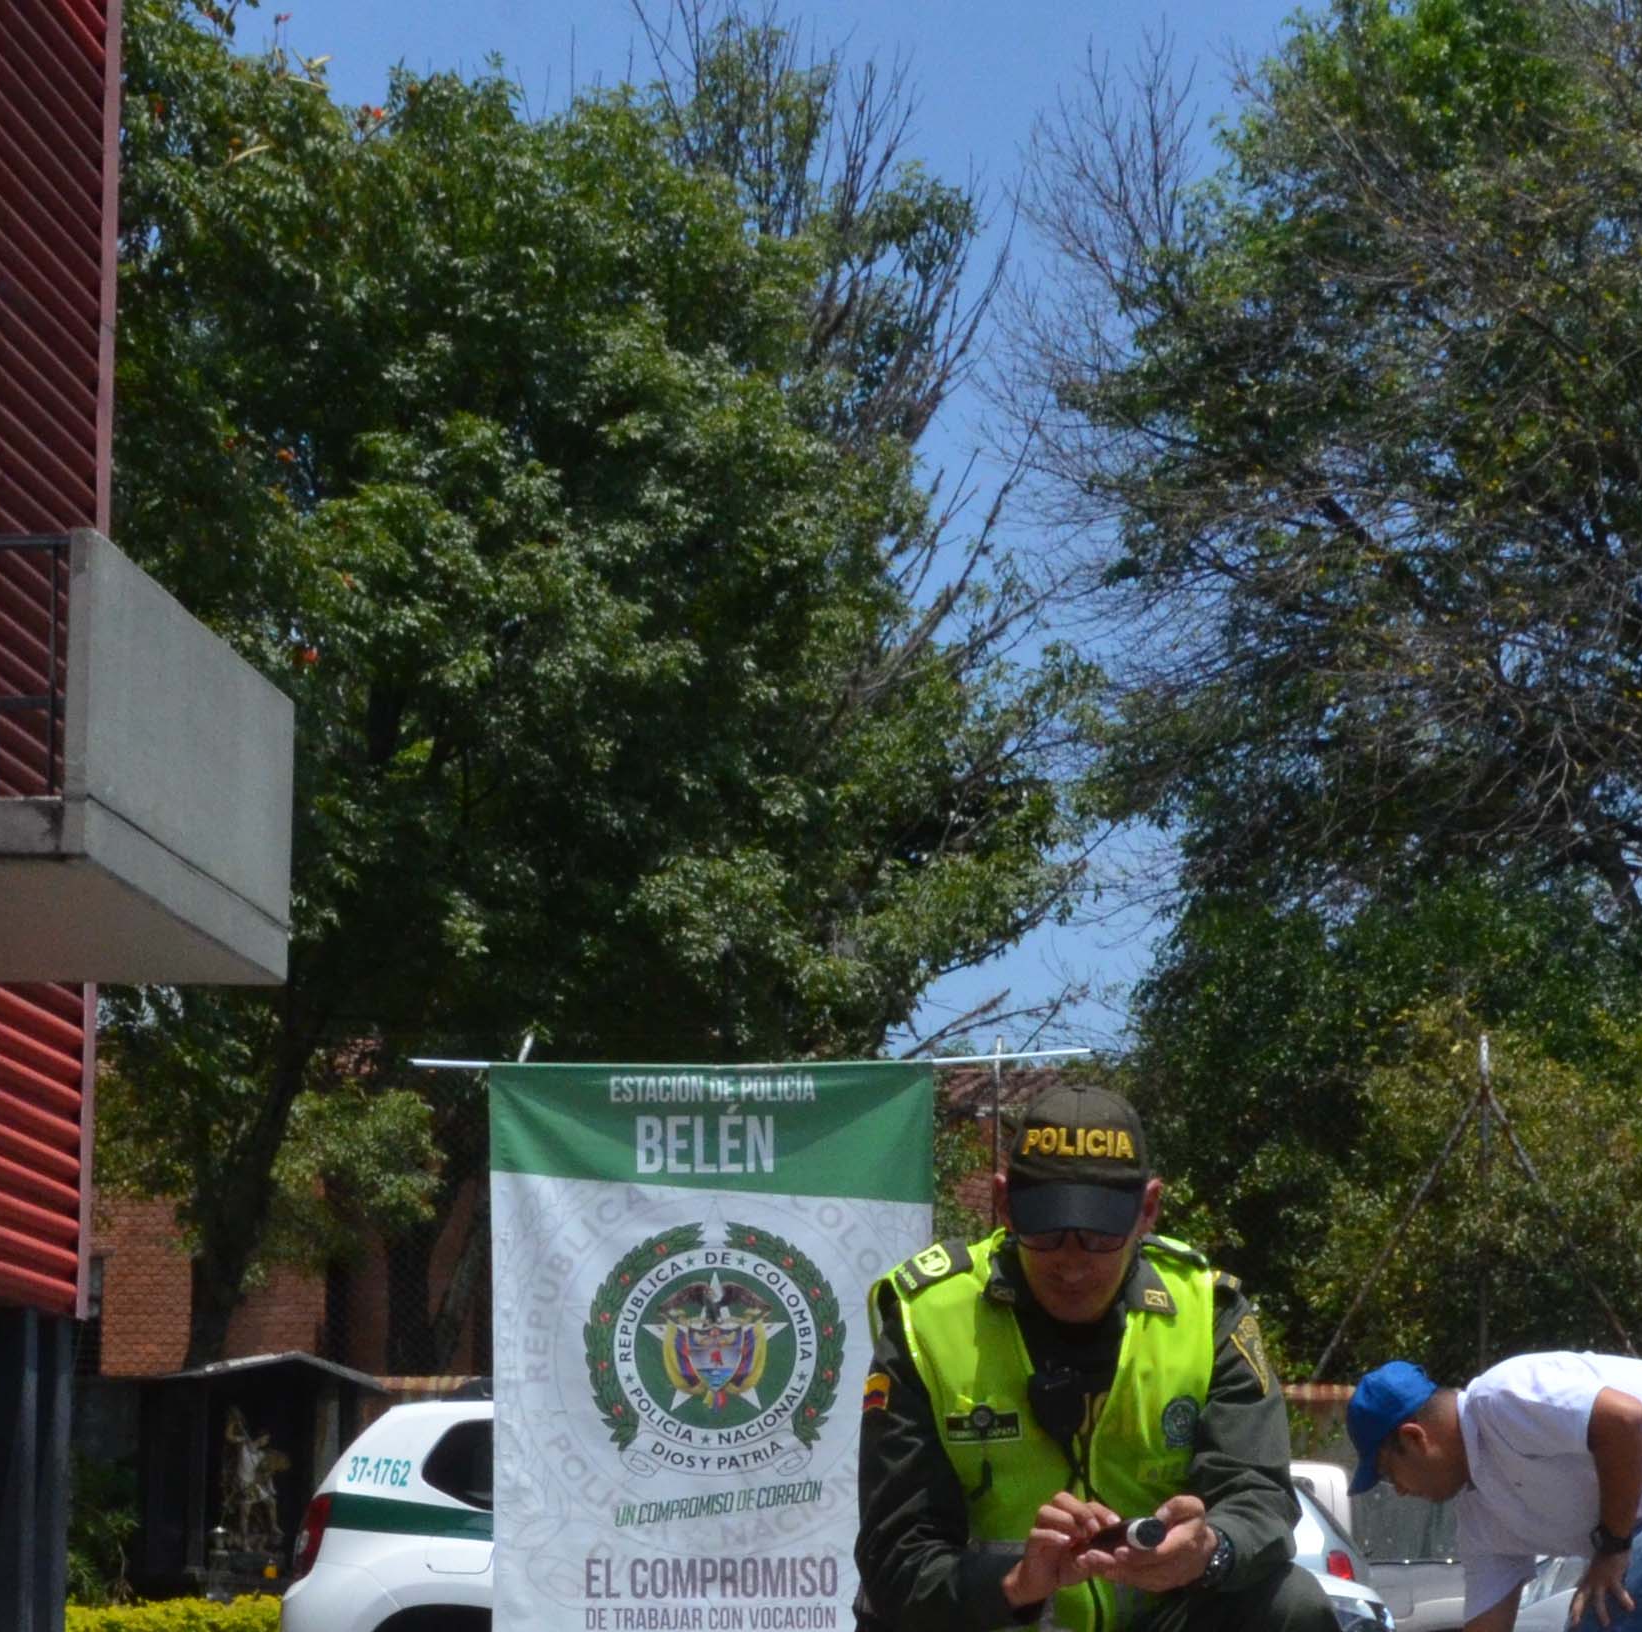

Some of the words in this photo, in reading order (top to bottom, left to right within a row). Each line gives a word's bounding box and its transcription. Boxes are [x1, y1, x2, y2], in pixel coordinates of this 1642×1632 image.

[609, 1073, 704, 1103] ESTACIÓN
[709, 1074, 734, 1102] DE
[739, 1073, 816, 1103] POLICÍA
[636, 1107, 774, 1174] BELÉN
[1020, 1126, 1135, 1160] POLICIA
[705, 1252, 731, 1265] DE
[753, 1263, 813, 1361] COLOMBIA
[717, 1384, 805, 1445] NACIONAL
[346, 1456, 412, 1488] 37-1762
[650, 1441, 696, 1467] DIOS
[696, 1455, 711, 1470] Y
[717, 1440, 784, 1470] PATRIA
[614, 1504, 638, 1528] UN
[637, 1491, 734, 1526] COMPROMISO
[736, 1489, 756, 1512] DE
[585, 1557, 621, 1600] EL
[630, 1555, 838, 1600] COMPROMISO
[585, 1608, 607, 1631] DE
[613, 1607, 704, 1631] TRABAJAR
[708, 1606, 745, 1631] CON
[750, 1602, 837, 1630] VOCACIÓN
